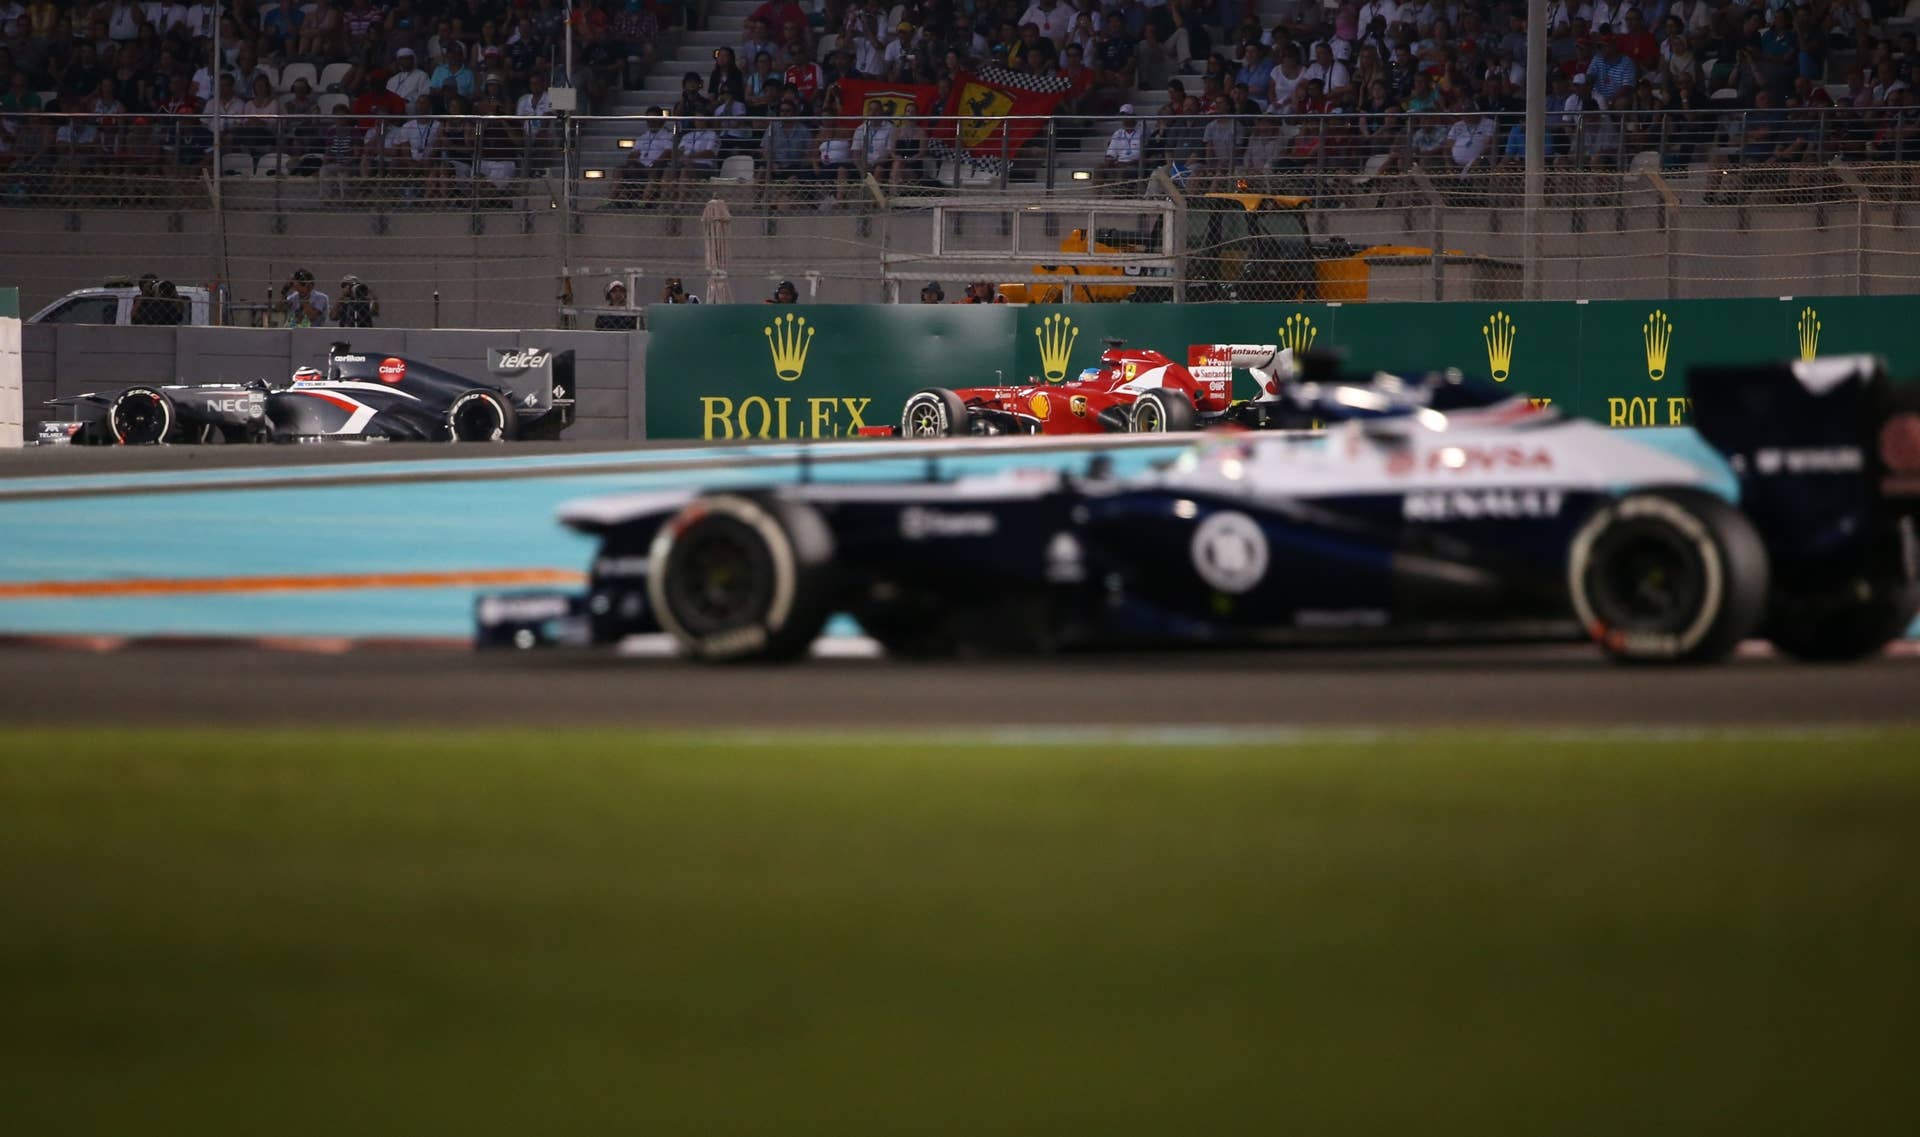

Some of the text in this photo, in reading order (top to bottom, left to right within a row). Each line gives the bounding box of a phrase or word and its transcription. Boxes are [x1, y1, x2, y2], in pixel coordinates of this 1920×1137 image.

[499, 350, 550, 368] telcel
[379, 364, 402, 374] Claro
[206, 399, 249, 412] NEC
[700, 396, 872, 440] ROLEX
